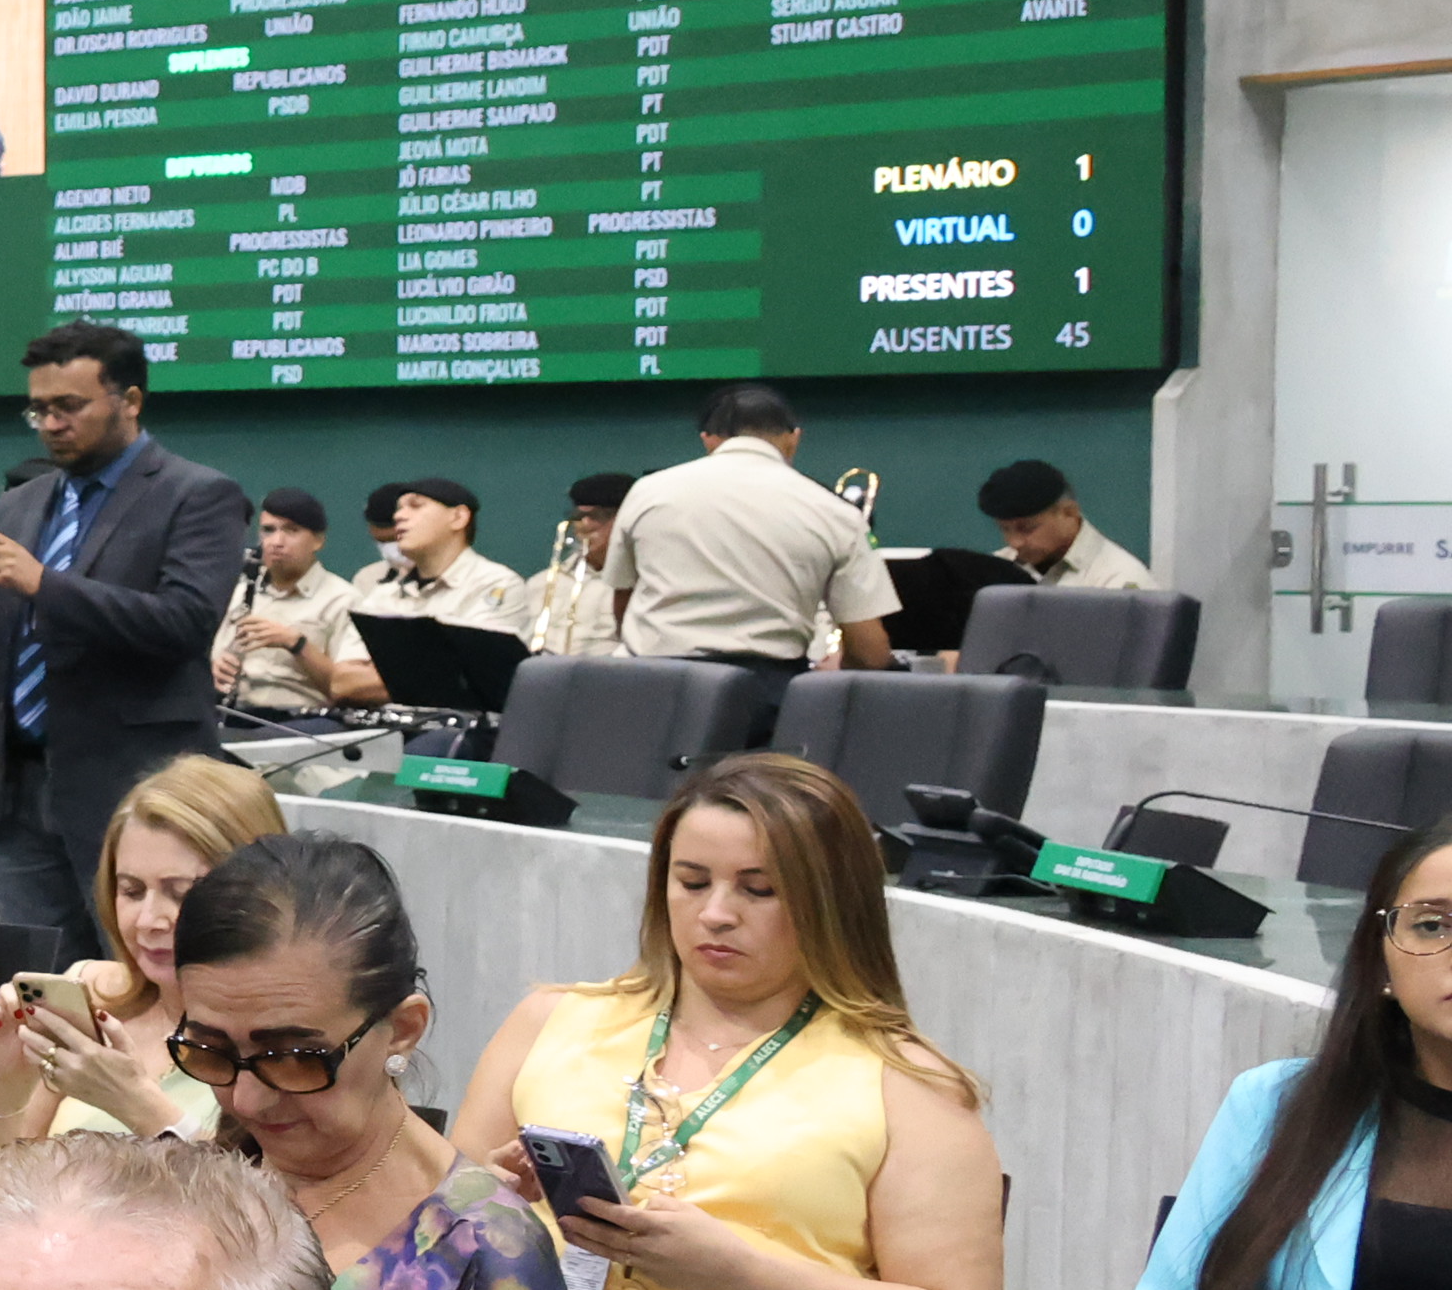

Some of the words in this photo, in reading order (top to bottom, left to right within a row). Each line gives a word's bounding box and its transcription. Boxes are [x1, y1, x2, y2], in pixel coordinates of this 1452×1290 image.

[771, 18, 834, 45] STUART
[836, 12, 903, 39] CASTRO
[637, 34, 671, 57] PDT
[637, 64, 671, 86] PDT
[641, 93, 664, 115] PT
[636, 122, 670, 144] PDT
[641, 151, 663, 172] PT
[873, 156, 1018, 194] PLENÁRIO
[1075, 153, 1092, 182] 1
[641, 180, 663, 201] PT
[278, 203, 298, 223] PL
[588, 206, 717, 234] PROGRESSISTAS
[895, 214, 1014, 246] VIRTUAL
[1073, 209, 1093, 237] 0
[635, 238, 669, 260] PDT
[634, 267, 668, 288] PSD
[860, 269, 1015, 303] PRESENTES
[1074, 266, 1090, 294] 1
[635, 296, 668, 318] PDT
[635, 325, 668, 347] PDT
[869, 324, 1012, 354] AUSENTES
[1056, 321, 1090, 348] 45
[640, 354, 661, 375] PL
[752, 1039, 782, 1065] ALECE
[694, 1089, 727, 1121] ALECE
